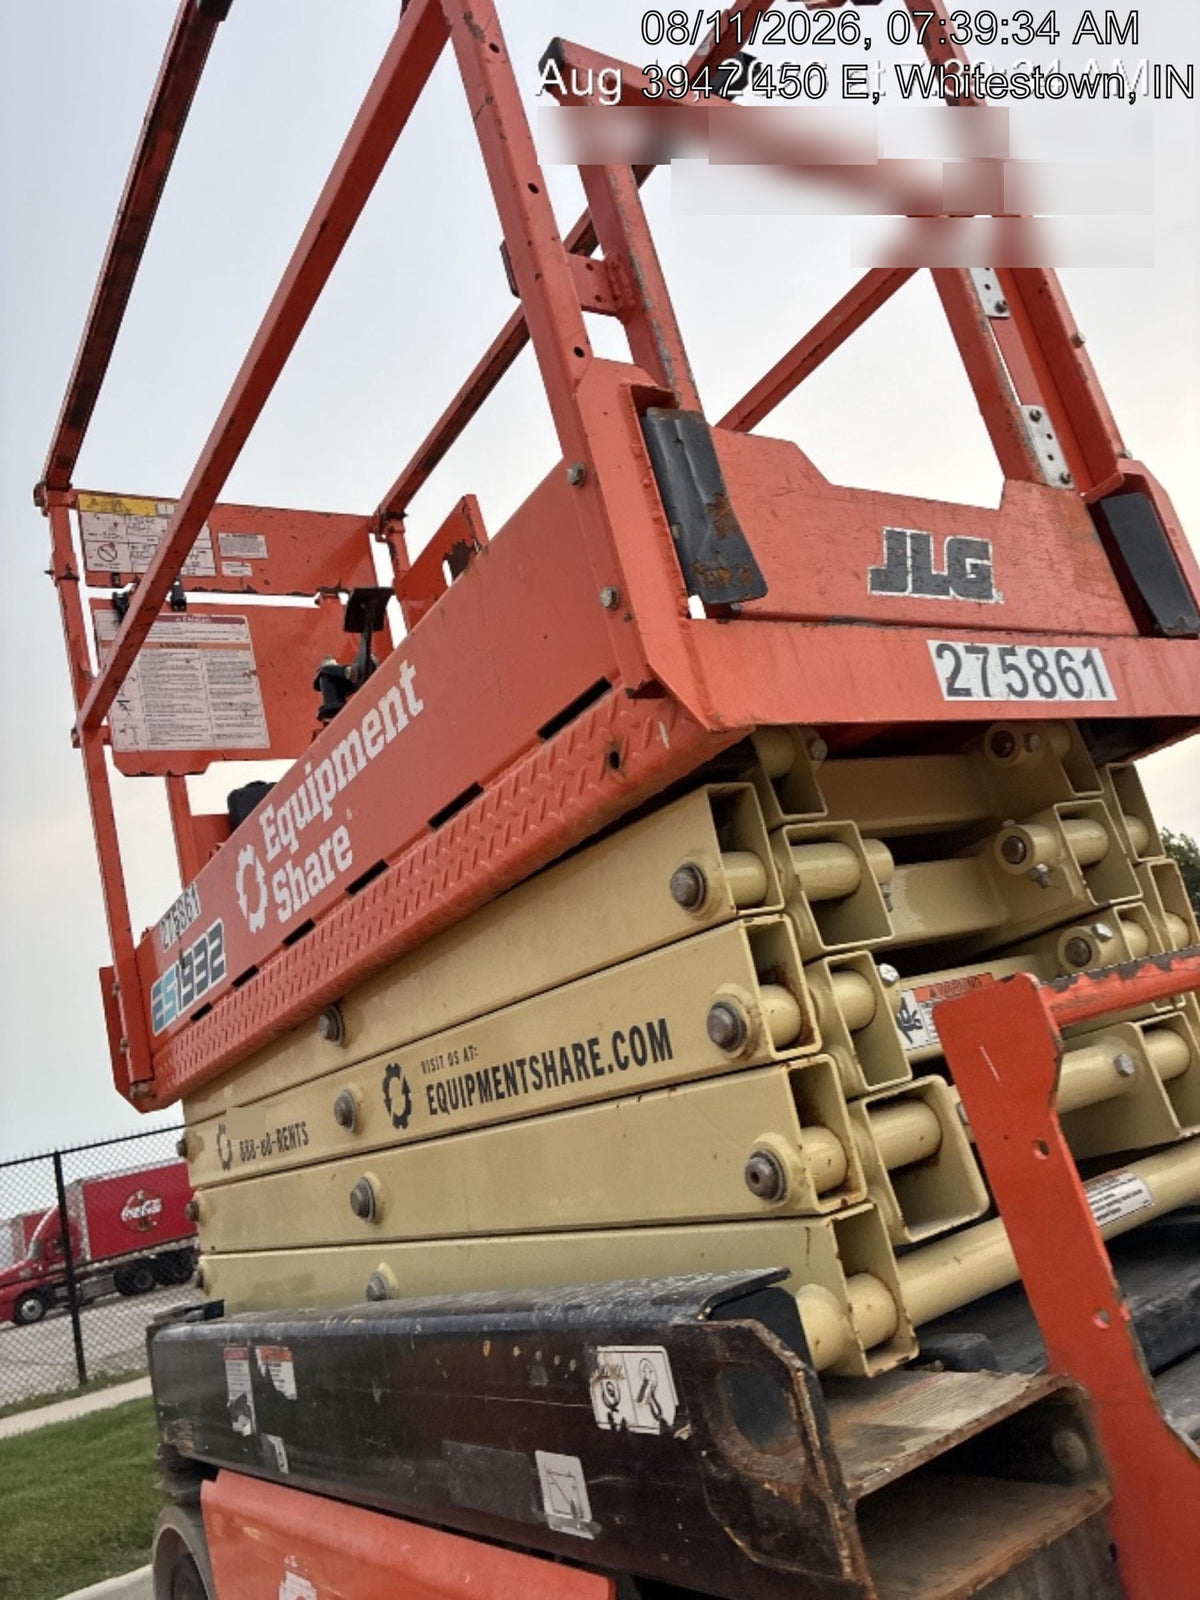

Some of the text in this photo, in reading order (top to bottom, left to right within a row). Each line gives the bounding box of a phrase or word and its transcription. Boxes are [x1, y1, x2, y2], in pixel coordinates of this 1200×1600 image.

[867, 526, 997, 603] JLG
[935, 643, 1108, 699] 275861
[259, 659, 425, 863] Equipment
[272, 824, 353, 924] Share
[151, 917, 227, 1036] ES1932
[426, 1018, 673, 1116] EQUIPMENTSHARE.COM
